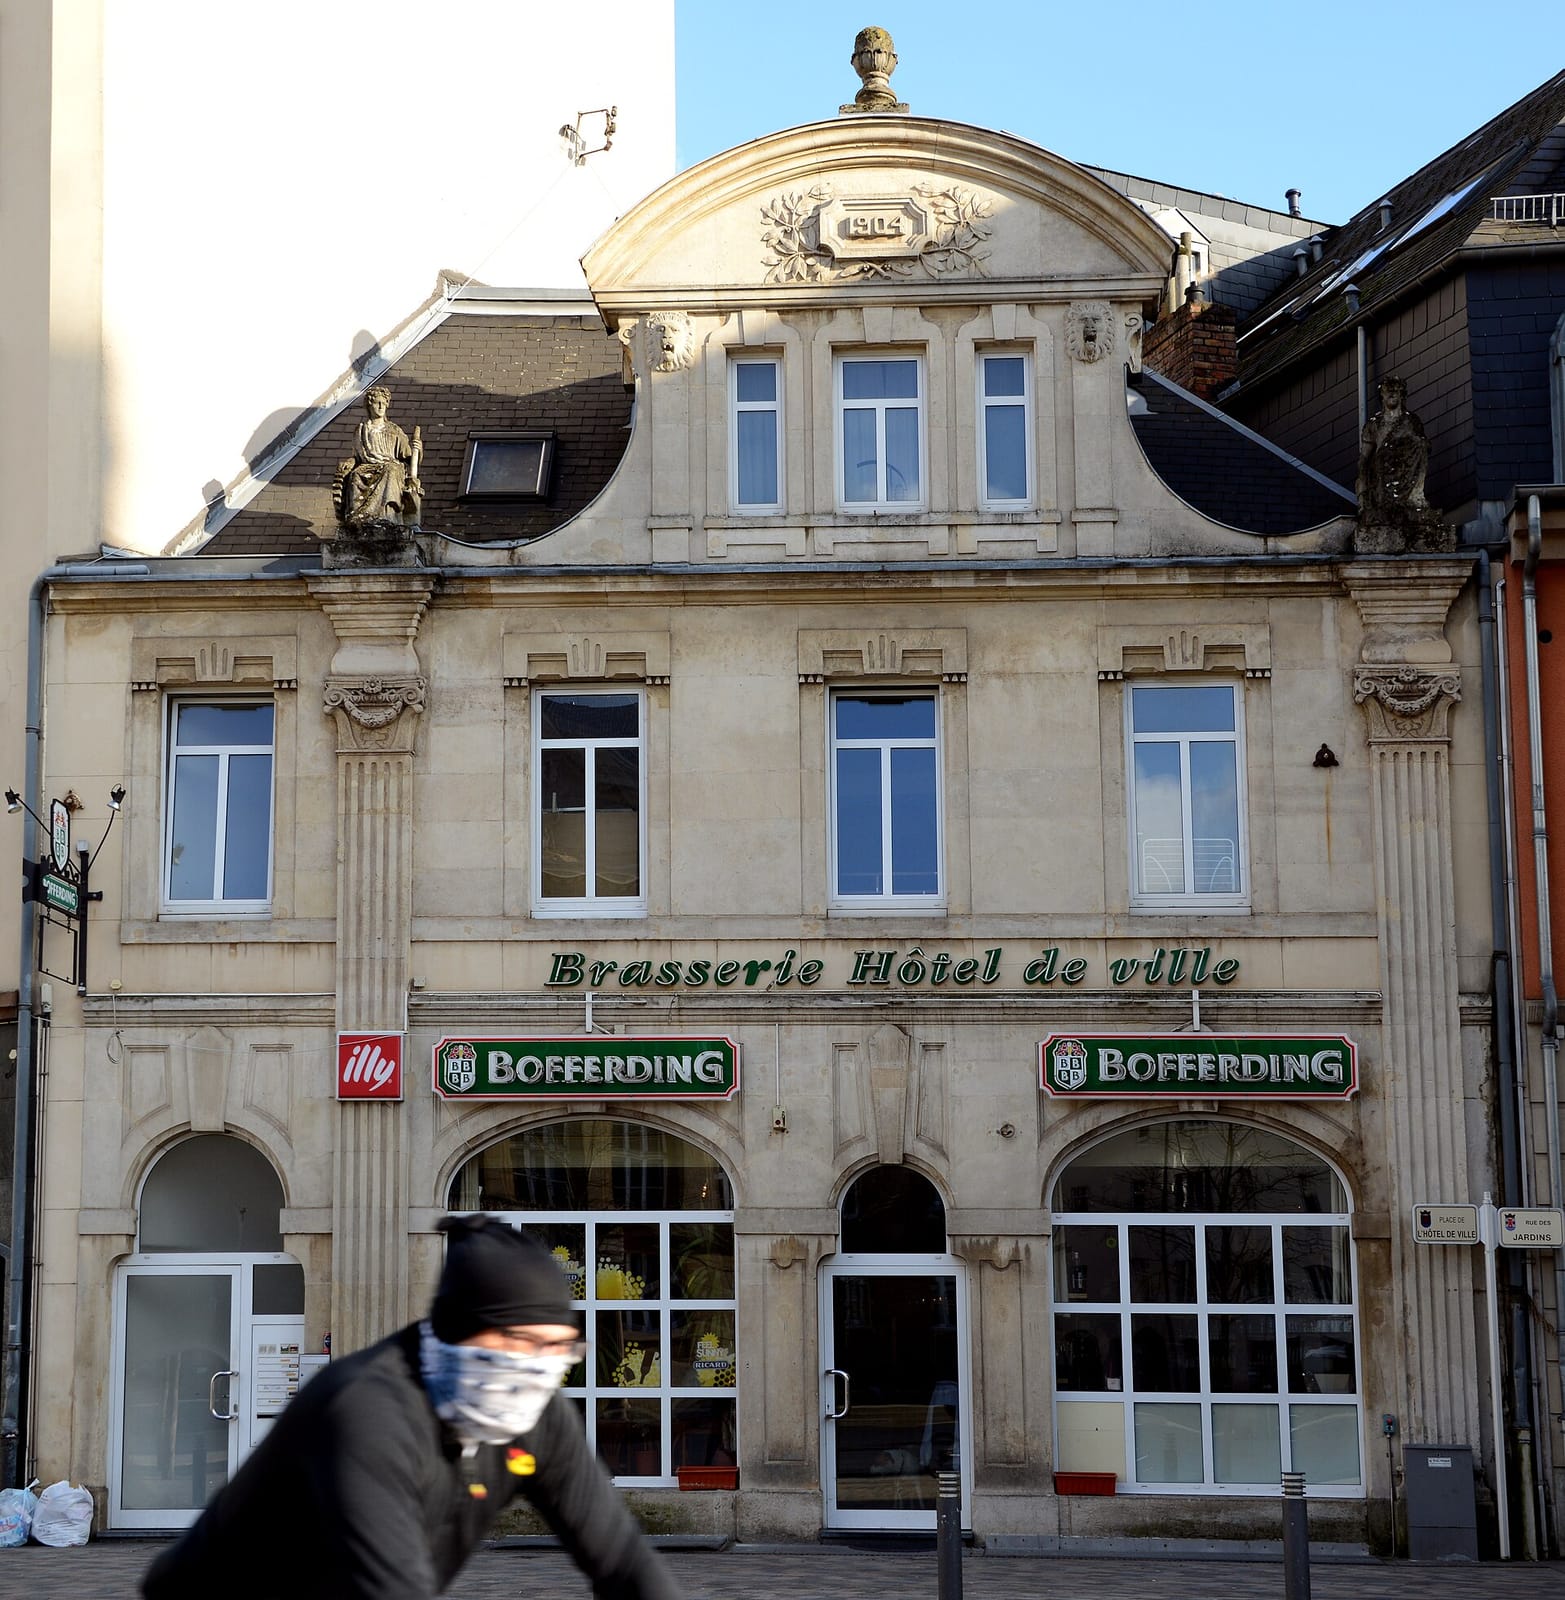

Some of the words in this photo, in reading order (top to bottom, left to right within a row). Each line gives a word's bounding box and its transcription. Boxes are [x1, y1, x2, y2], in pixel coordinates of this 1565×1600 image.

[848, 216, 903, 236] 1904
[544, 949, 824, 986] Brasserie
[847, 946, 1003, 985] Hôtel
[1023, 948, 1088, 985] de
[1109, 947, 1241, 985] ville
[342, 1044, 396, 1092] illy
[487, 1050, 725, 1084] BOFFERDING
[1097, 1048, 1343, 1083] BOFFERDING
[1417, 1228, 1445, 1238] L'HÔTEL
[1446, 1230, 1456, 1238] DE
[1457, 1230, 1476, 1239] VILLE
[1439, 1216, 1456, 1224] PLACE
[1457, 1216, 1465, 1224] DE
[1513, 1234, 1552, 1242] JARDINS
